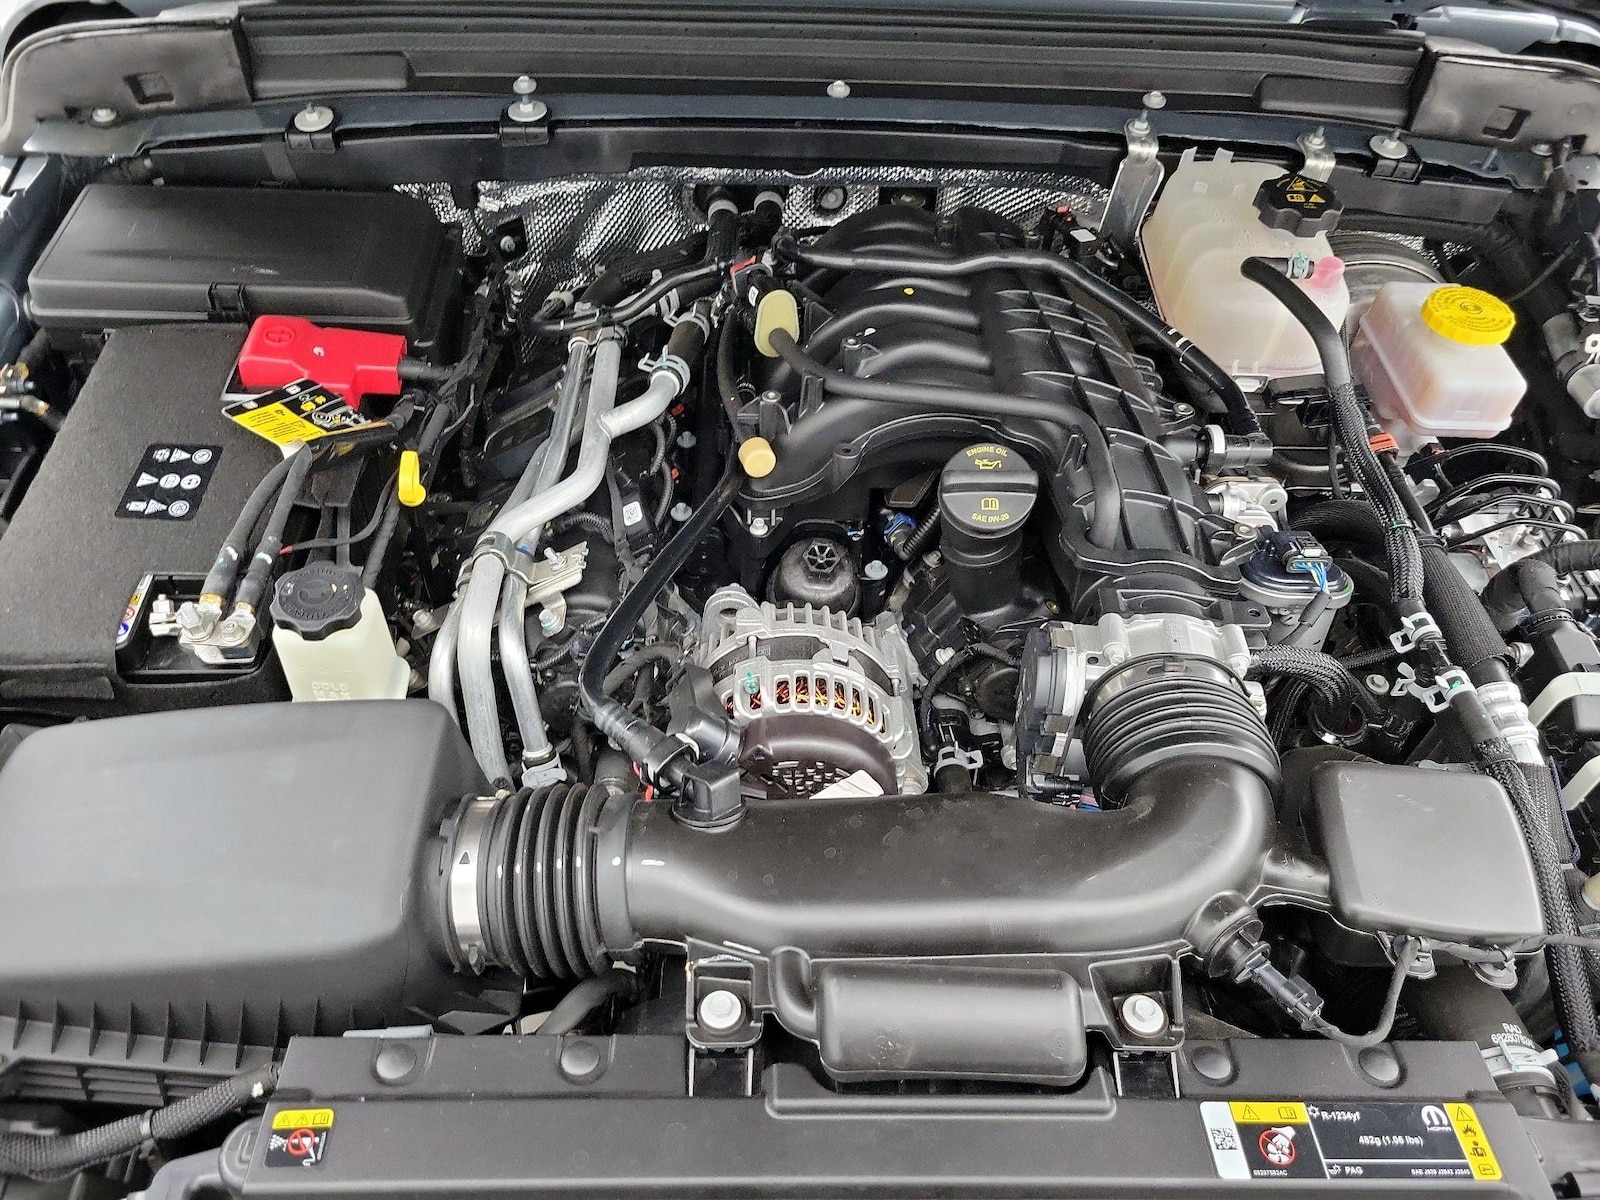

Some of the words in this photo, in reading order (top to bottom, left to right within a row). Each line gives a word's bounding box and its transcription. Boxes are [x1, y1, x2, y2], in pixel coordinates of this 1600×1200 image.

[966, 446, 994, 457] ENGINE
[995, 447, 1008, 457] OIL
[971, 513, 987, 522] SAE
[988, 512, 1009, 523] 0W-20
[311, 681, 349, 691] COLD
[1502, 1023, 1521, 1034] RAD
[1321, 1111, 1360, 1122] R-1234yf
[1358, 1135, 1382, 1146] 482g
[1405, 1135, 1424, 1147] lbs)
[1345, 1166, 1364, 1175] PAG
